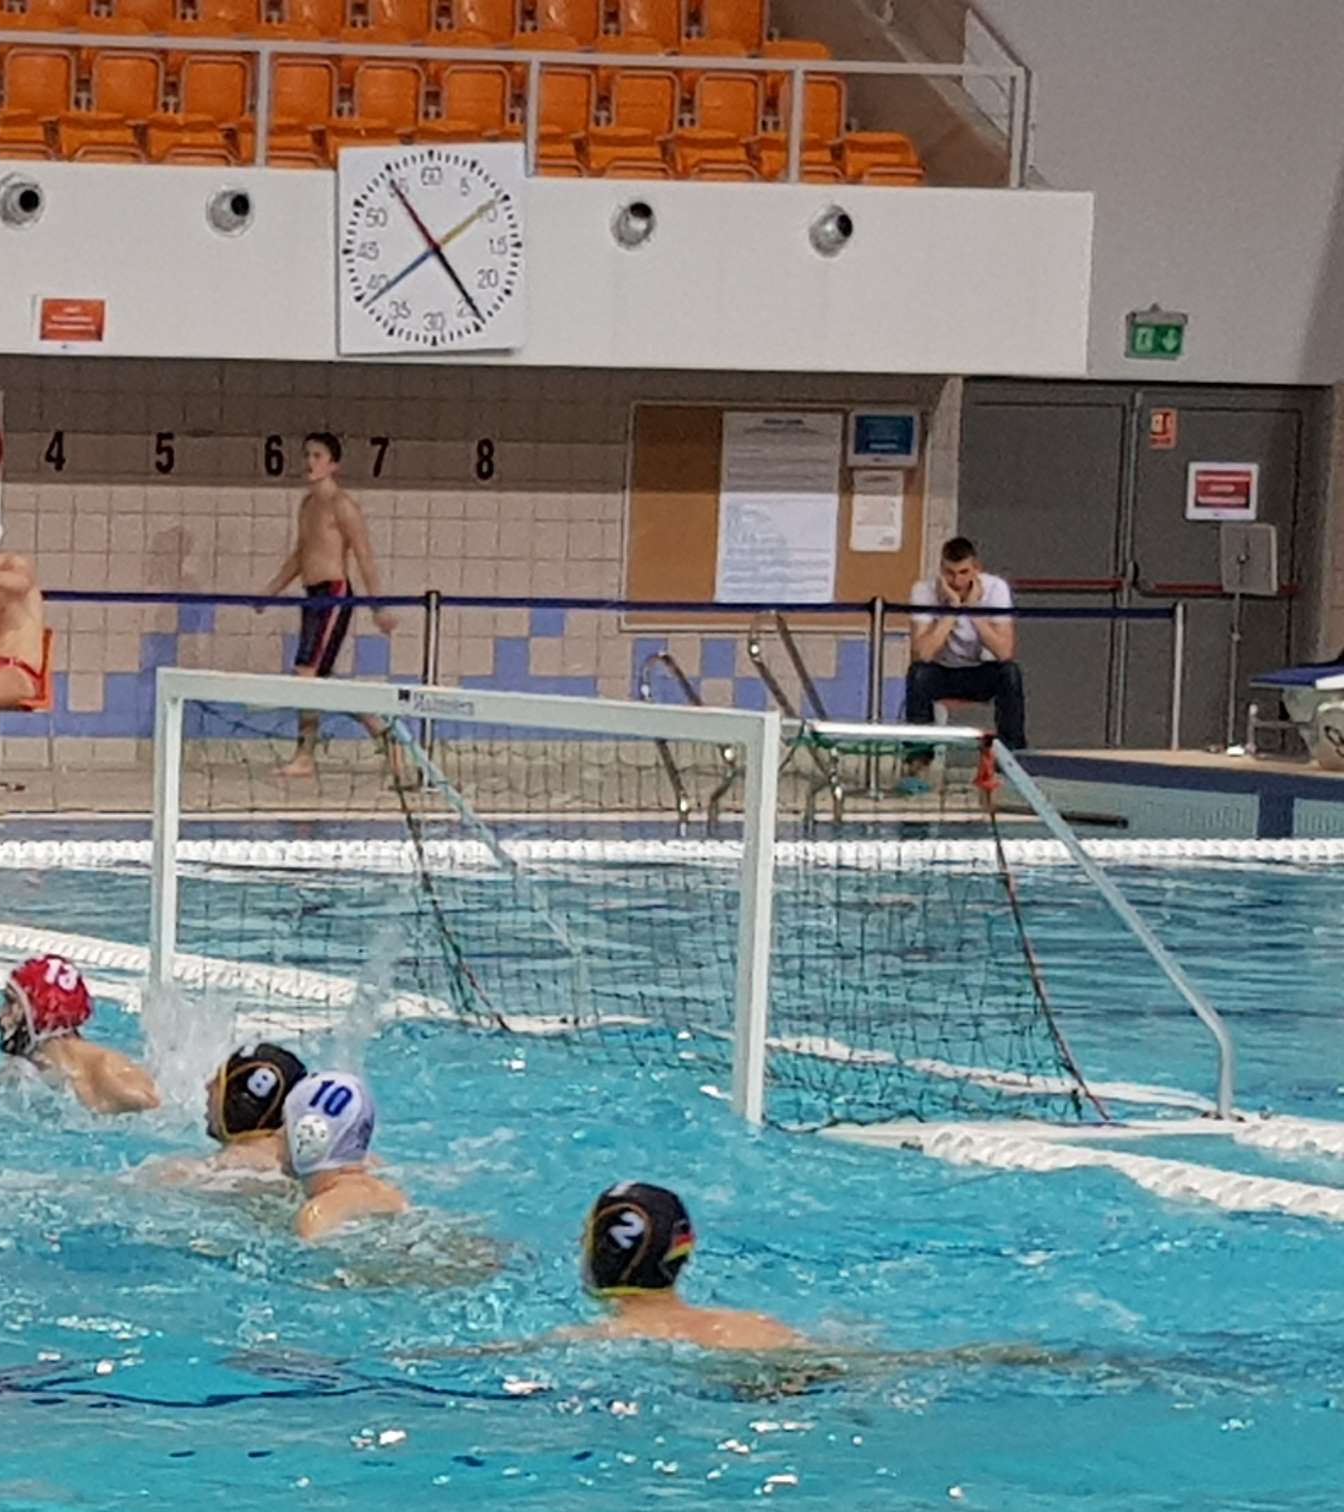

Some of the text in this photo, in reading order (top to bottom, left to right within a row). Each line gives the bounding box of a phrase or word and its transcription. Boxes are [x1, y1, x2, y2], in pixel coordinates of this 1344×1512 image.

[366, 207, 388, 227] 50
[477, 268, 499, 289] 20
[423, 311, 445, 332] 30
[45, 431, 66, 471] 4
[155, 432, 175, 474] 5
[264, 435, 284, 476] 6
[370, 437, 390, 477] 7
[475, 438, 495, 480] 8
[247, 1067, 278, 1098] 8
[309, 1079, 353, 1118] 10
[609, 1210, 645, 1249] 2
